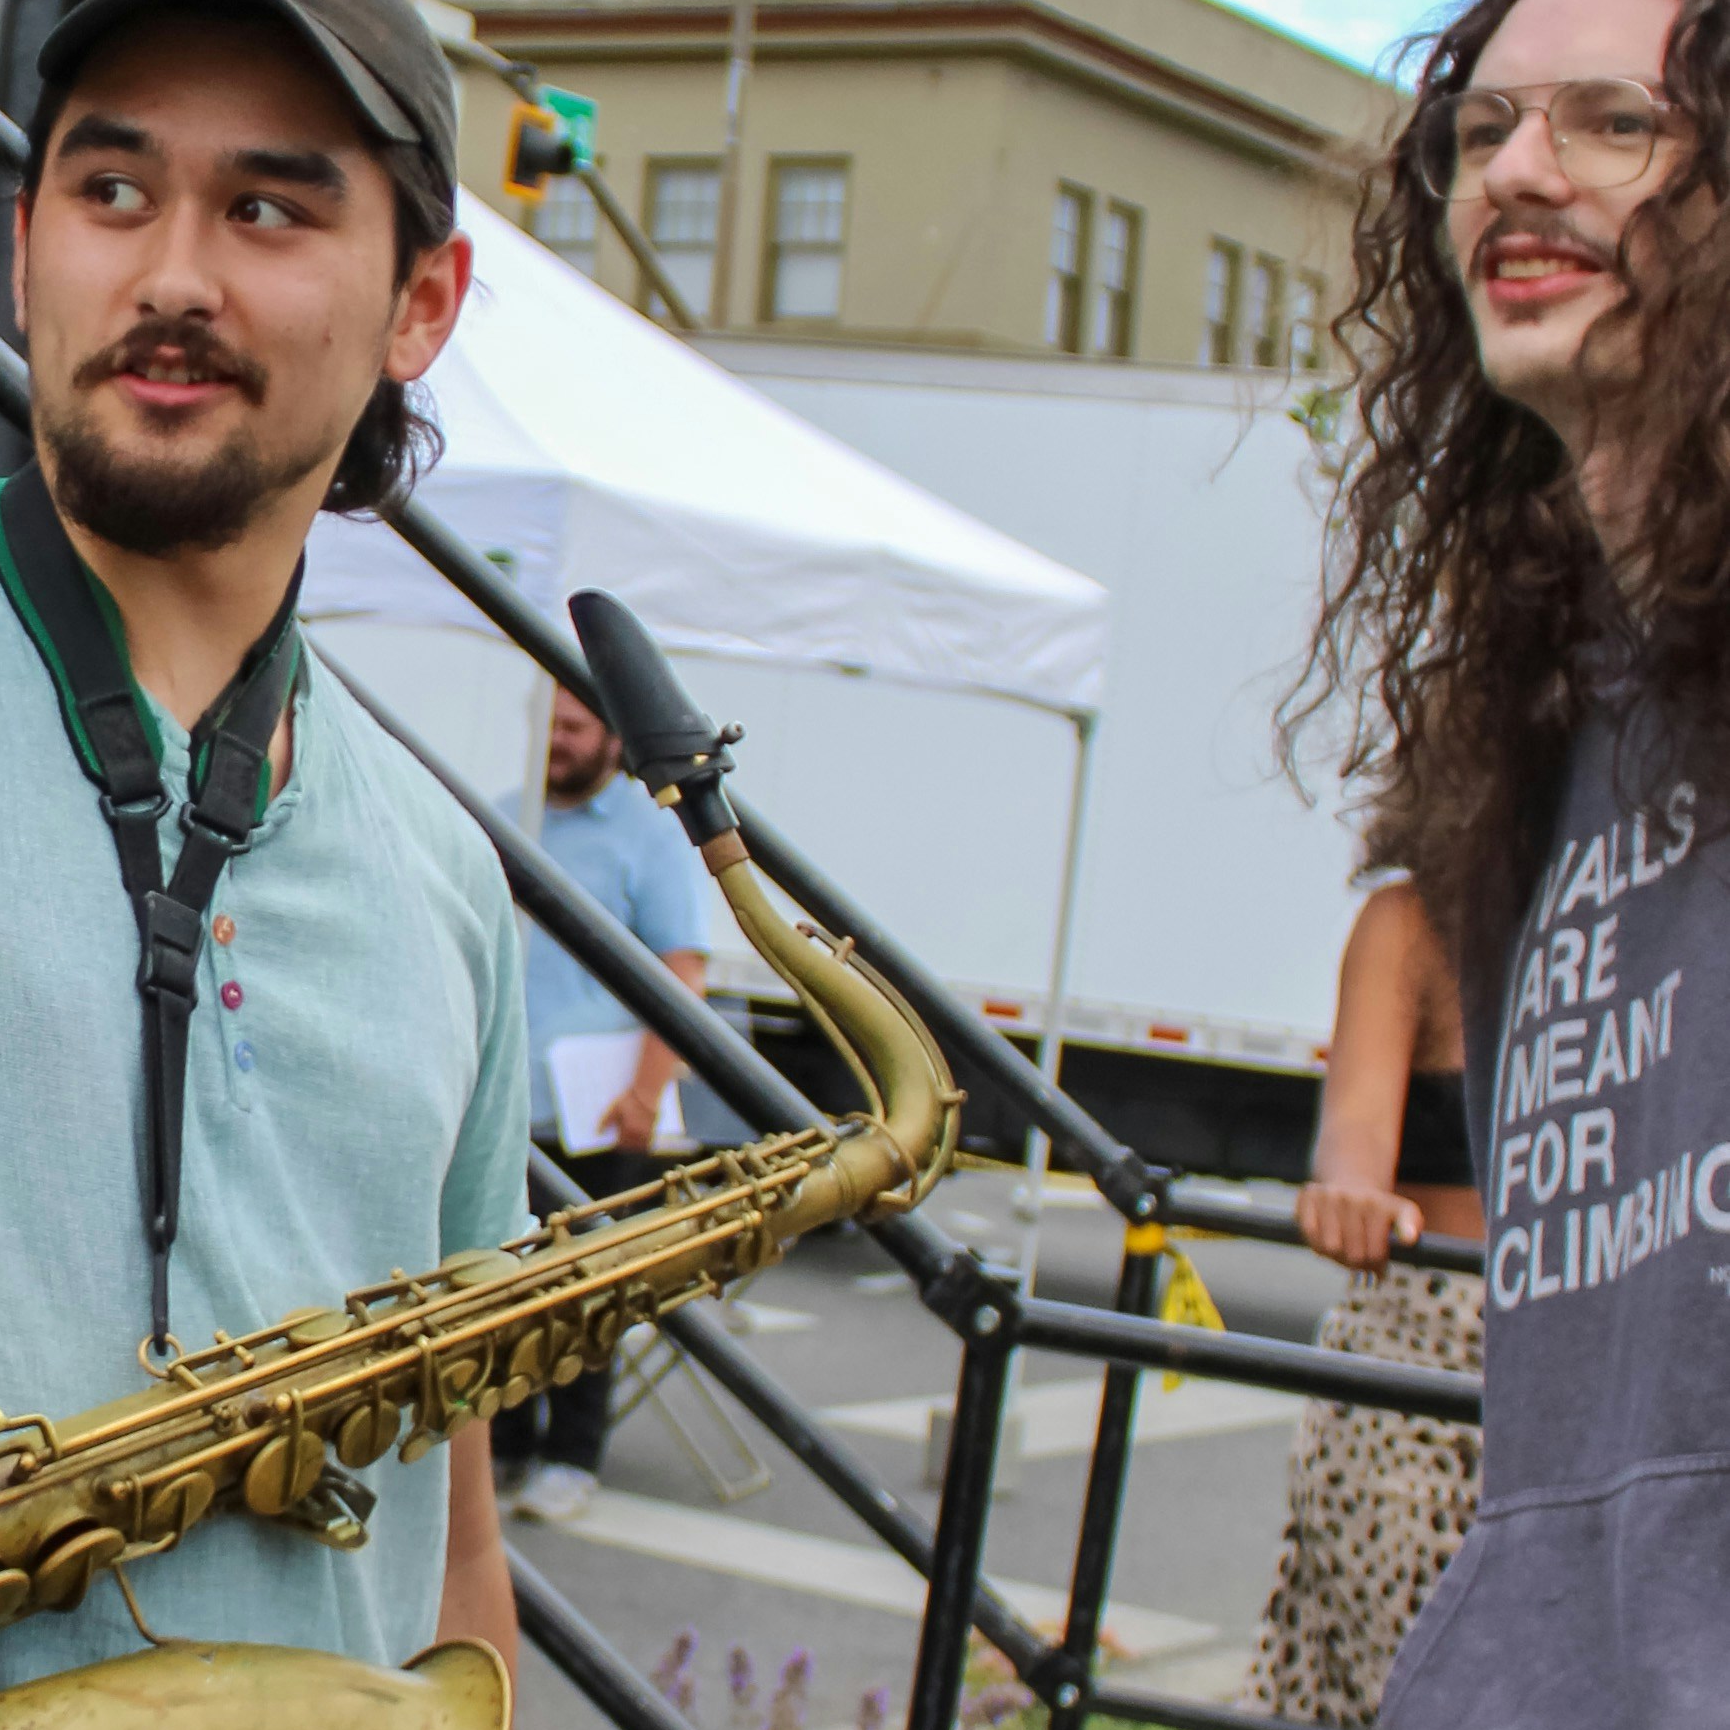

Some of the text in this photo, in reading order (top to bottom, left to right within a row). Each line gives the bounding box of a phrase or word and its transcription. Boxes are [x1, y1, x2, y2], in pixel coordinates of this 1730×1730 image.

[1514, 913, 1620, 1031] ARE
[1505, 969, 1683, 1124] MEANT
[1496, 1109, 1616, 1218] FOR
